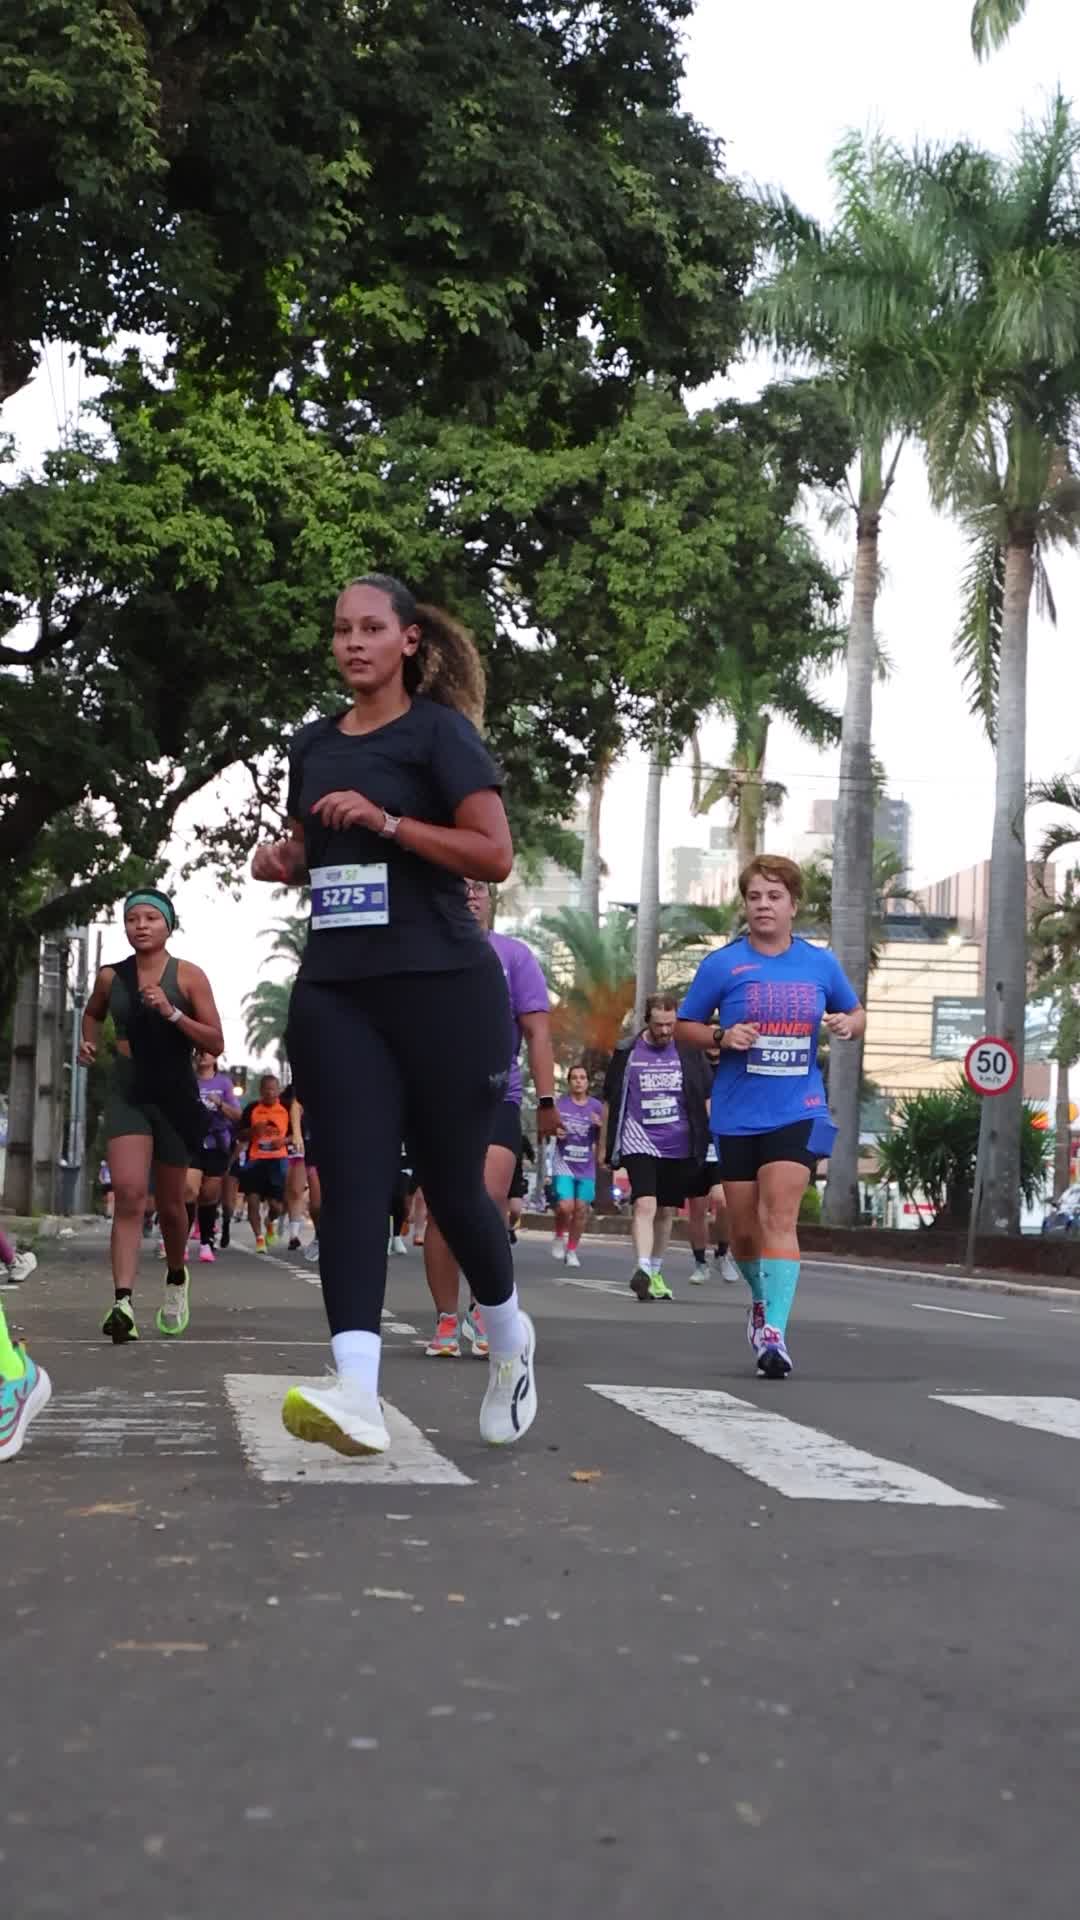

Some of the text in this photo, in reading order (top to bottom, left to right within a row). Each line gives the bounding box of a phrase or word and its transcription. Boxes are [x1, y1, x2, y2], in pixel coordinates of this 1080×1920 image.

[322, 887, 365, 907] 5275
[761, 1049, 796, 1063] 5401
[976, 1050, 1006, 1075] 50
